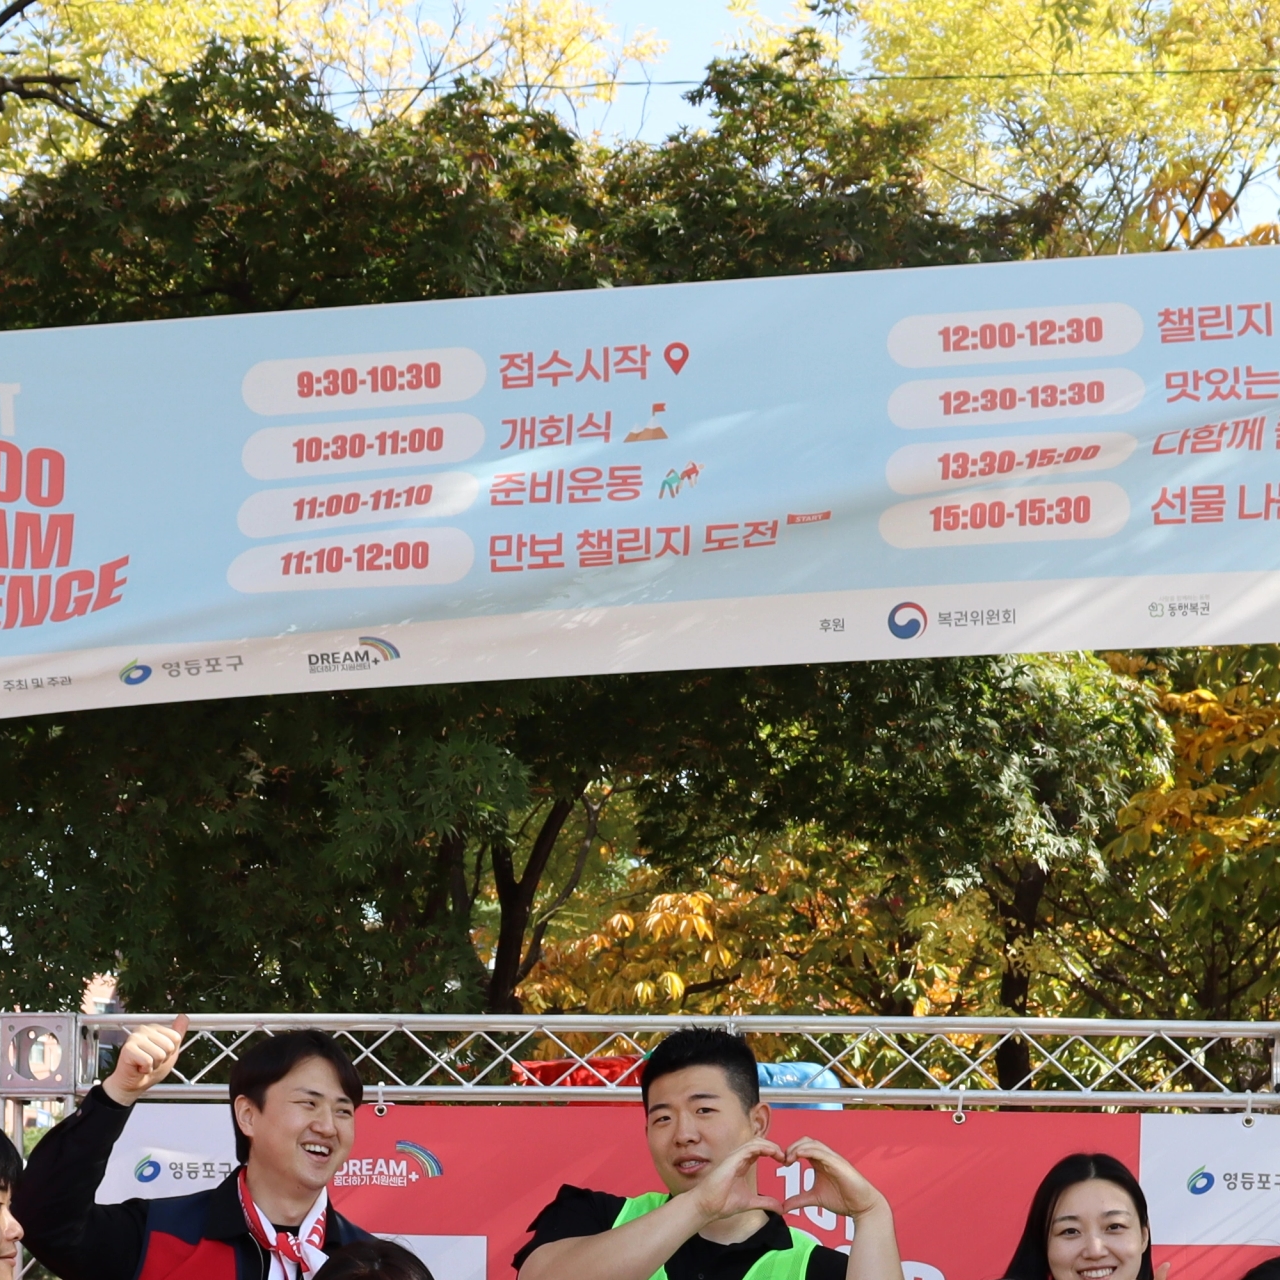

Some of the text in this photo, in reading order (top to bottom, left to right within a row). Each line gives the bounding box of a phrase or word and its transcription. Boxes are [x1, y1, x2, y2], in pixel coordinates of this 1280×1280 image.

[938, 316, 1104, 352] 12:00-12:30
[1159, 302, 1272, 344] 챌린지
[296, 361, 442, 398] 9:30-10:30
[499, 344, 651, 389] 접수시작
[1165, 366, 1280, 402] 맛있는
[939, 380, 1105, 415] 12:30-13:30
[292, 426, 444, 463] 10:30-11:00
[500, 411, 612, 450] 개회식
[1151, 416, 1265, 456] 다함께
[937, 444, 1101, 480] 13:30-15:00
[293, 484, 433, 522] 11:00-11:10
[489, 465, 643, 507] 준비운동
[795, 513, 823, 522] START
[929, 495, 1092, 532] 15:00-15:30
[1151, 485, 1227, 526] 선물
[281, 541, 430, 576] 11:10-12:00
[489, 520, 780, 573] 만보 챌린지 도전
[818, 616, 846, 634] 후원
[936, 607, 1017, 629] 복권위원회
[1168, 601, 1210, 618] 동행복권
[2, 675, 73, 693] 주최 및 주관
[160, 654, 245, 679] 영등포구
[169, 1161, 233, 1180] 영등포구
[333, 1175, 408, 1188] 꿈더하기 지원센터
